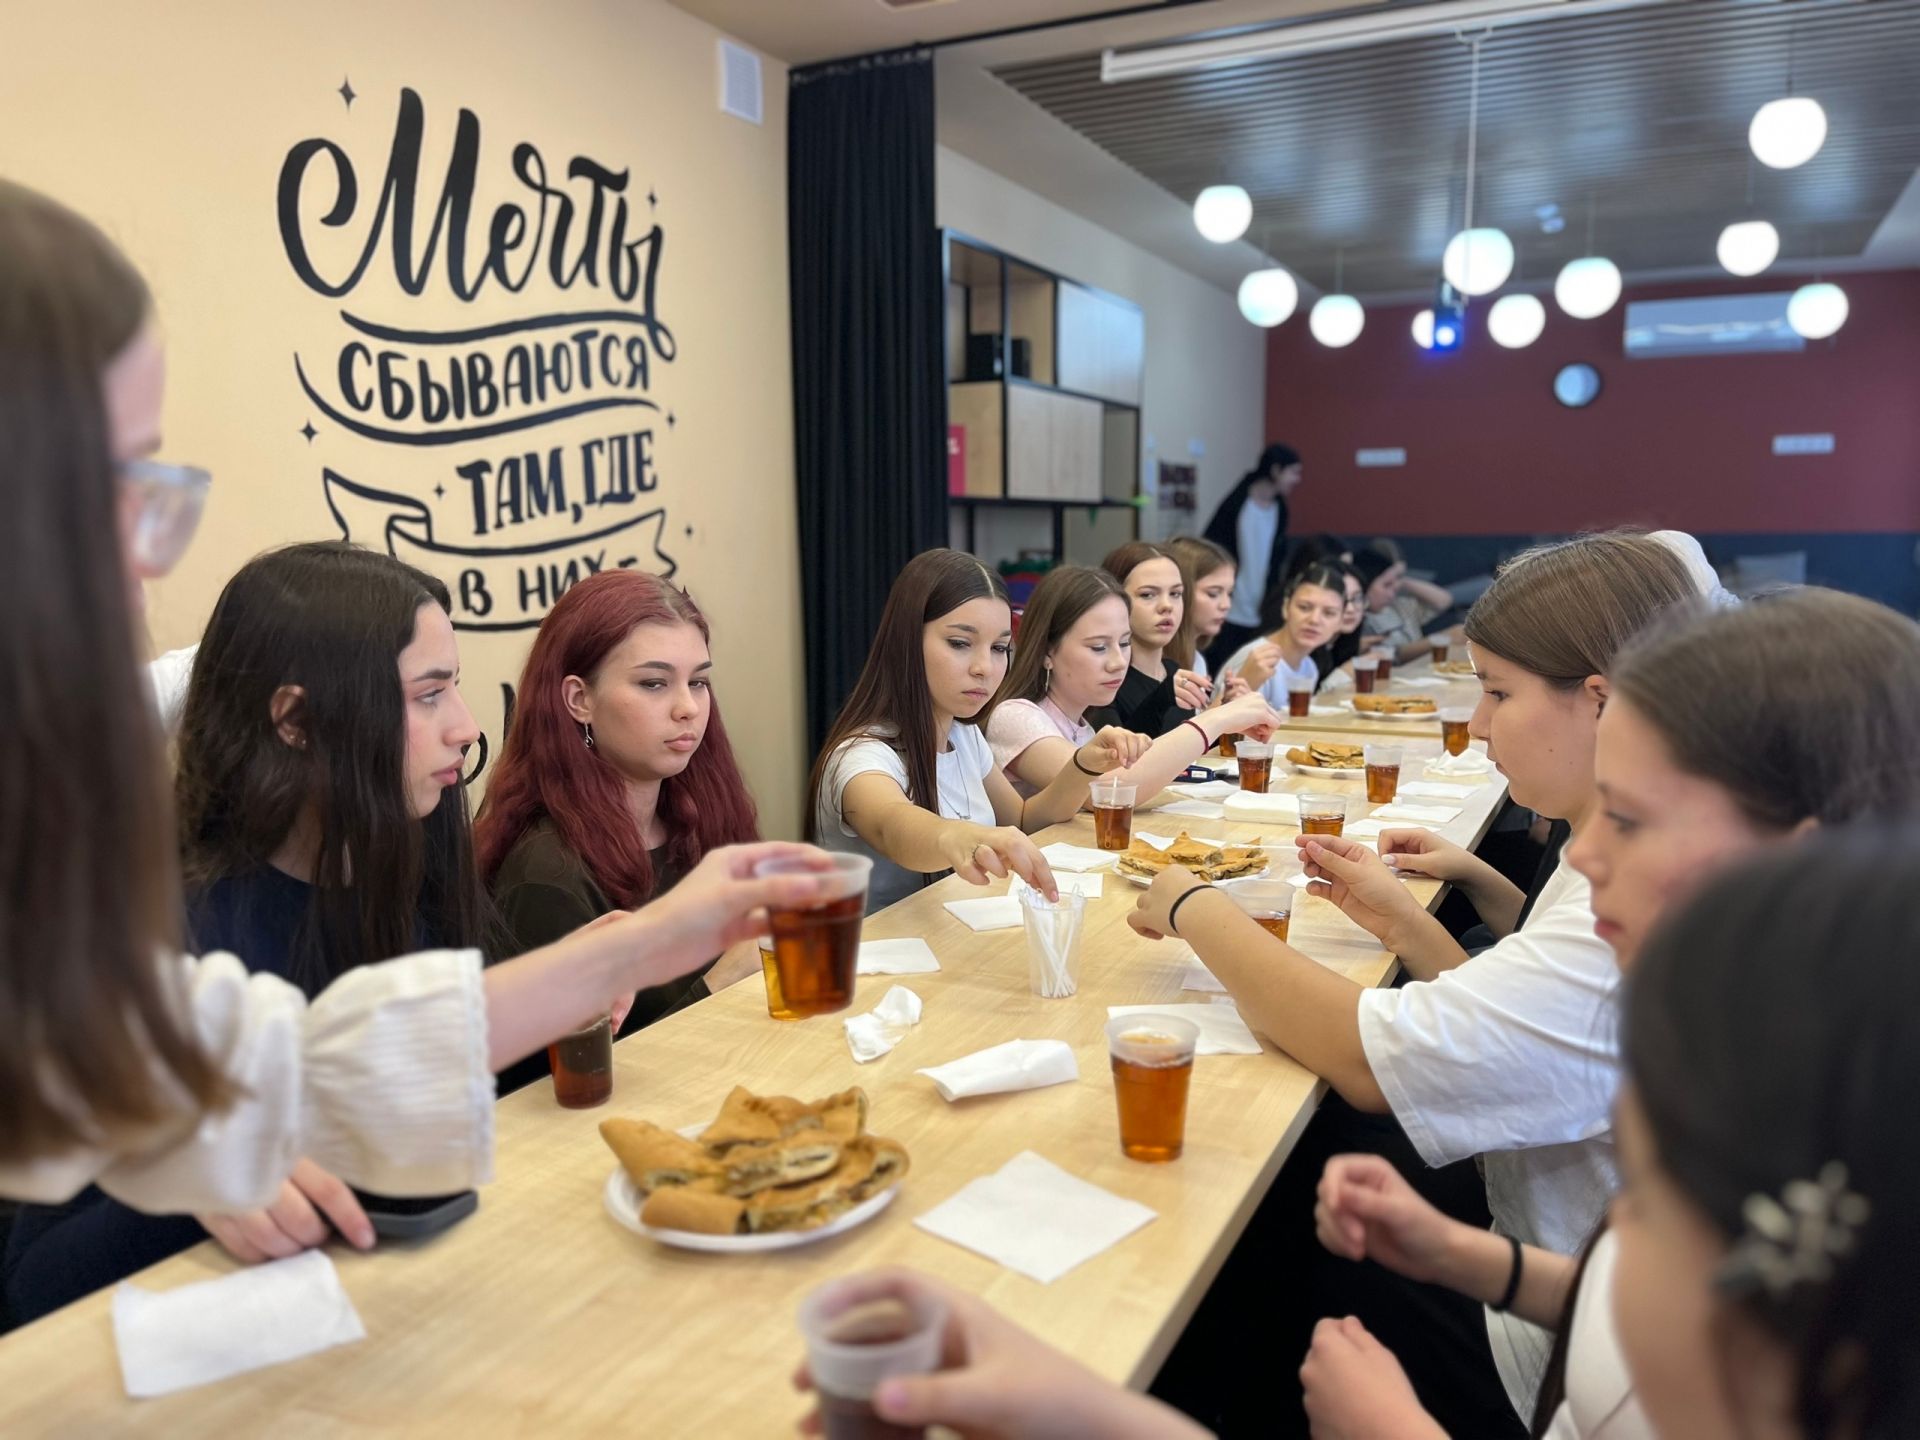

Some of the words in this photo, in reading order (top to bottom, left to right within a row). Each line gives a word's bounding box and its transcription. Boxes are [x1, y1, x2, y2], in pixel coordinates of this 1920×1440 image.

[278, 87, 666, 325] Мечты
[338, 329, 649, 423] СБЫВАЮТСЯ
[459, 568, 493, 617] В
